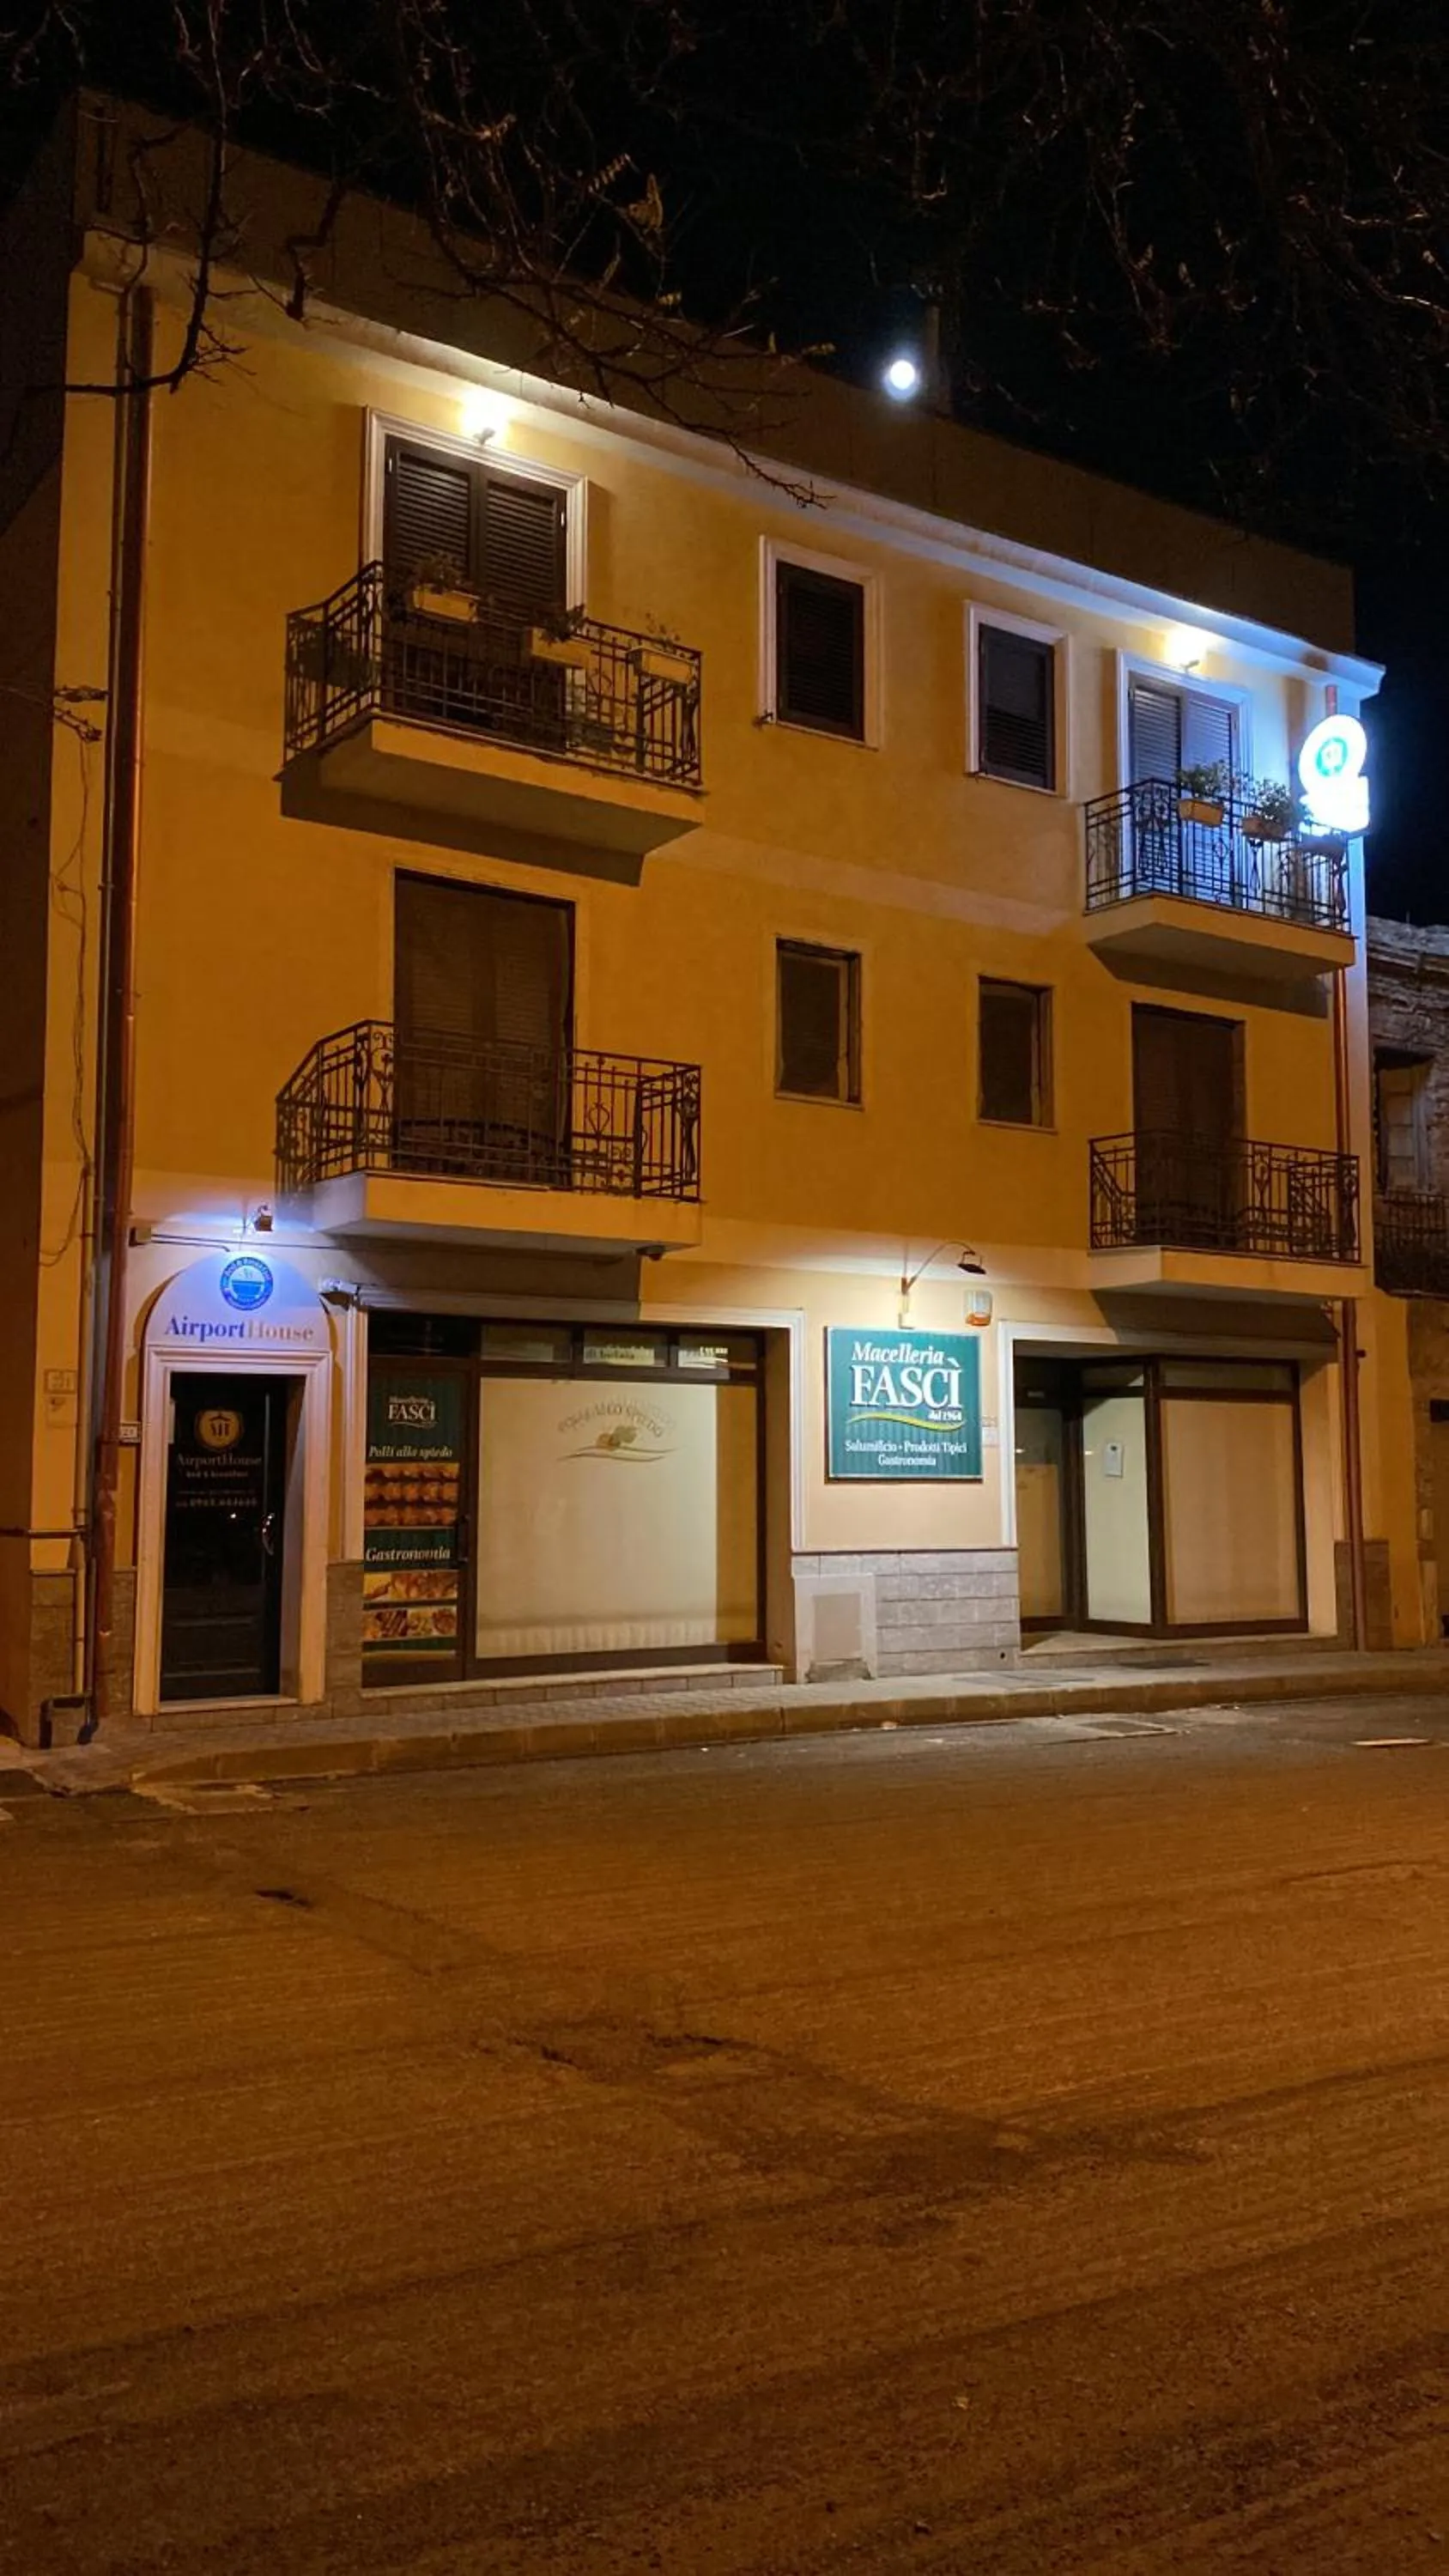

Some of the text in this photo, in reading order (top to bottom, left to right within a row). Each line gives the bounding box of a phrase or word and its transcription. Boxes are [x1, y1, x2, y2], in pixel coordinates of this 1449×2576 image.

[851, 1340, 944, 1365] Macelleria
[850, 1357, 962, 1409] FASCÌ
[845, 1439, 967, 1455] Salumificio Prodotti Tipici
[878, 1454, 937, 1467] Gastronomia
[365, 1545, 452, 1563] Gastronomia
